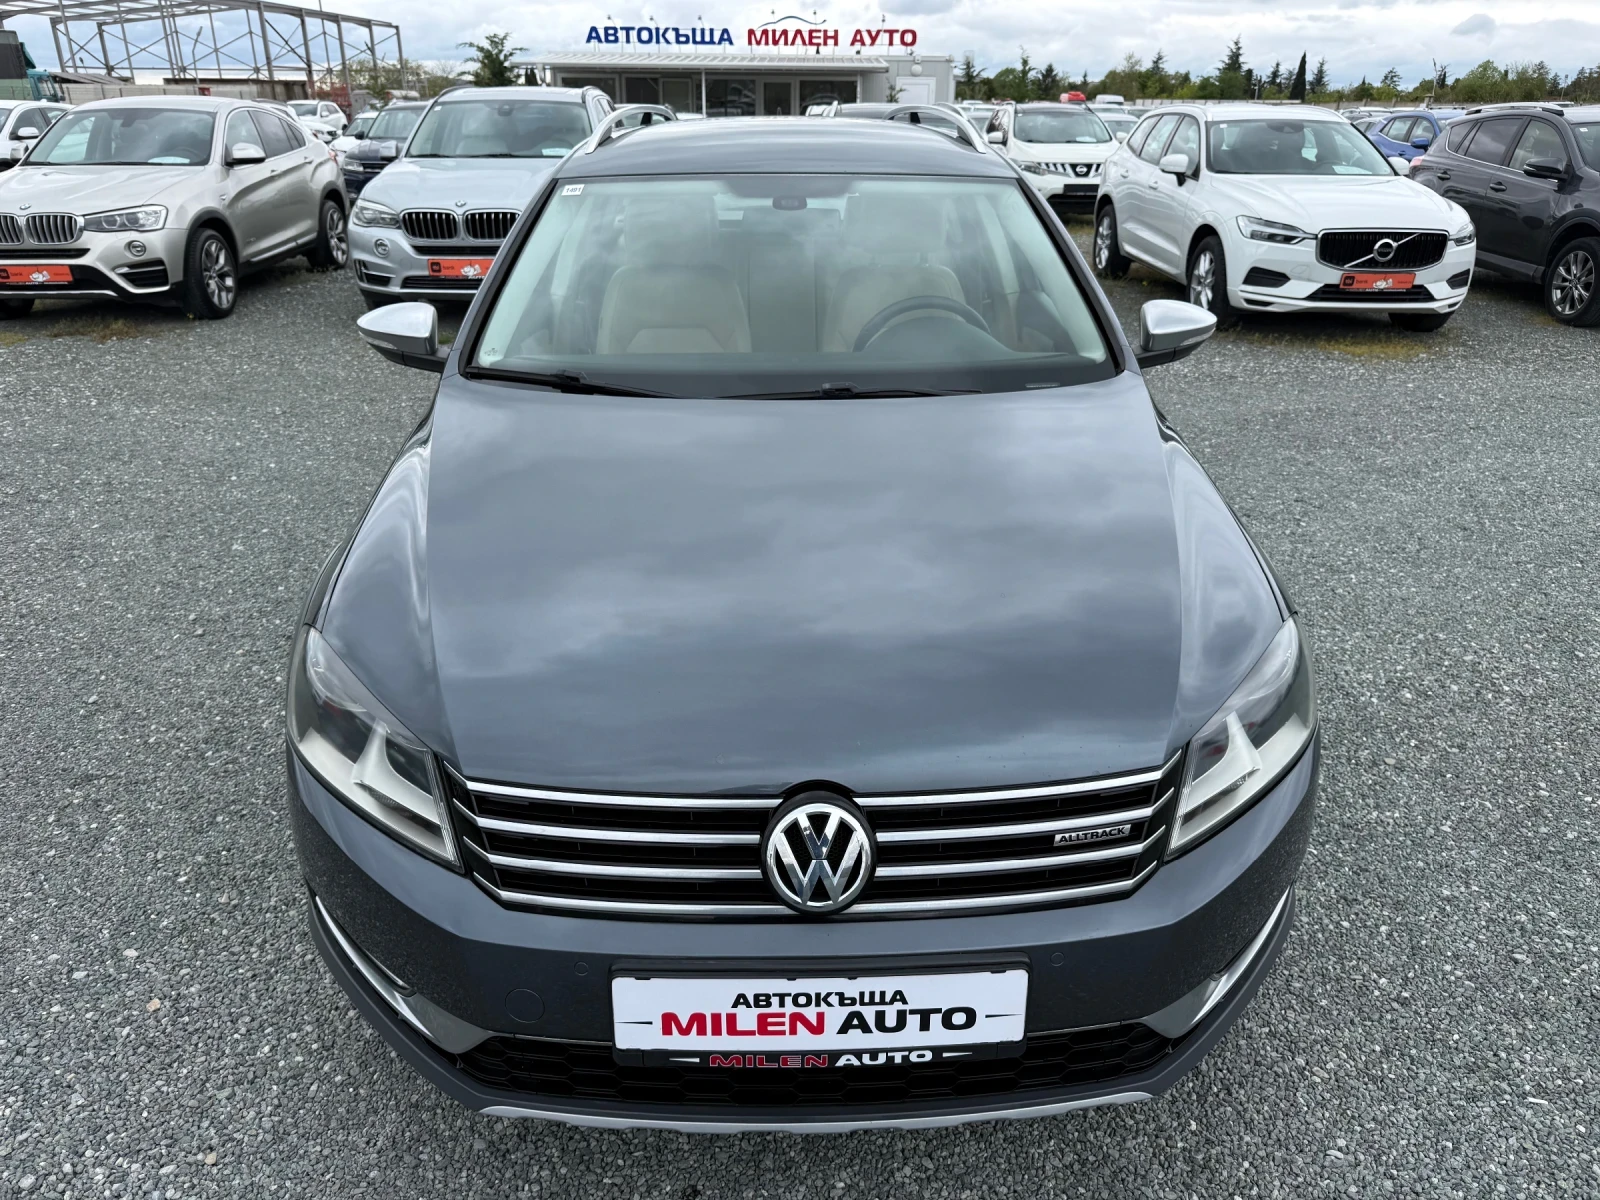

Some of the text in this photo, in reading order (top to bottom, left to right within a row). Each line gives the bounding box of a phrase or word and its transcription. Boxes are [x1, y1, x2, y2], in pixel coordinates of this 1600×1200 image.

[747, 28, 839, 47] МИЛЕН
[850, 28, 918, 47] АУТО
[1058, 826, 1126, 844] ALLTRACK
[661, 1006, 977, 1037] MILEN AUTO
[709, 1050, 933, 1068] MILEN AUTO
